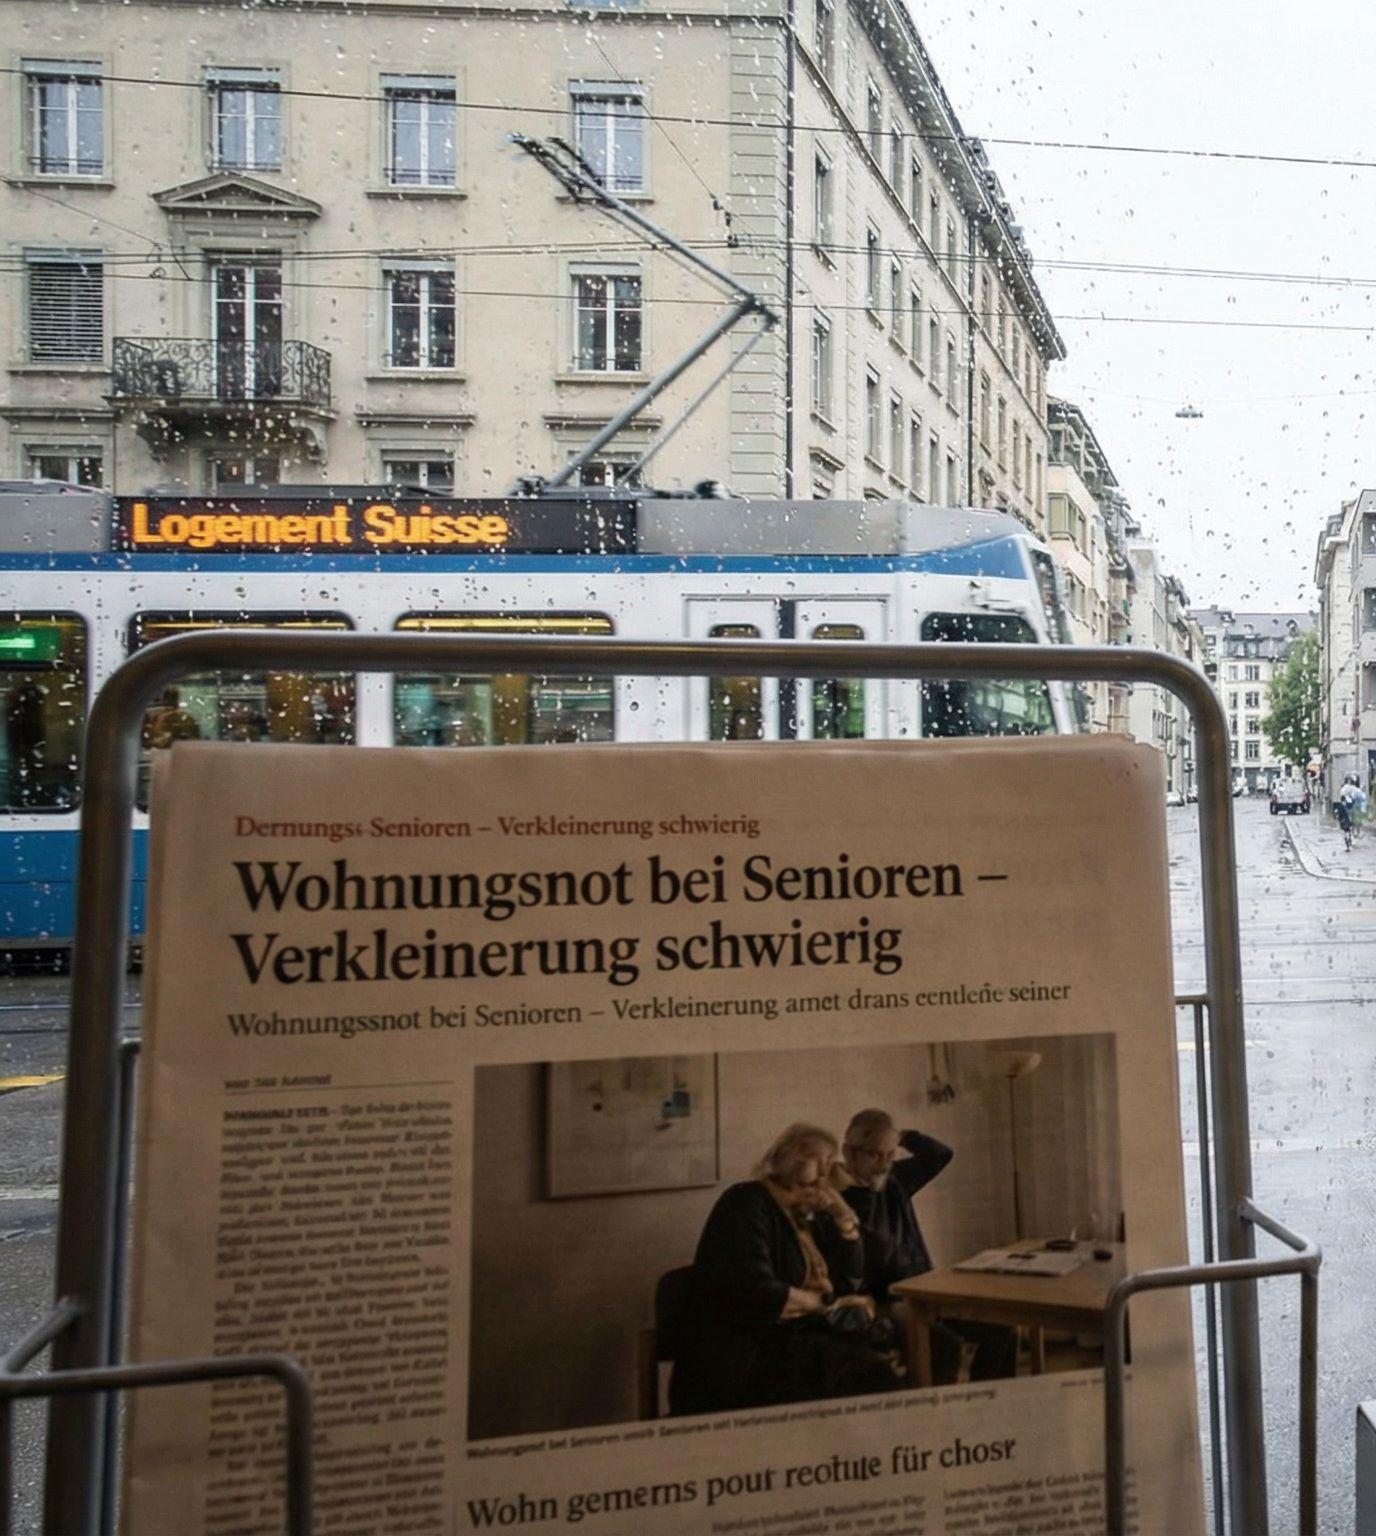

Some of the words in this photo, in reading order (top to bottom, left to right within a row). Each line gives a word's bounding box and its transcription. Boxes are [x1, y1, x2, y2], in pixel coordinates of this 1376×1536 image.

[132, 503, 352, 549] Logement
[364, 504, 509, 545] Suisse
[369, 817, 471, 838] Senioren
[497, 815, 652, 839] Verkleinerung
[658, 814, 760, 839] schwierig
[233, 858, 634, 921] Wohnungsnot
[647, 855, 728, 905] bei
[743, 852, 964, 902] Senioren
[230, 928, 640, 987] Verkleinerung
[655, 916, 903, 976] schwierig
[228, 1006, 420, 1040] Wohnungssnot
[430, 1004, 467, 1028] bei
[475, 1001, 582, 1028] Senioren
[612, 994, 779, 1021] Verkleinerung
[785, 992, 841, 1013] amet
[848, 987, 910, 1011] drans
[1009, 980, 1071, 1003] seiner
[467, 1491, 558, 1530] Wohn
[892, 1444, 933, 1475] für
